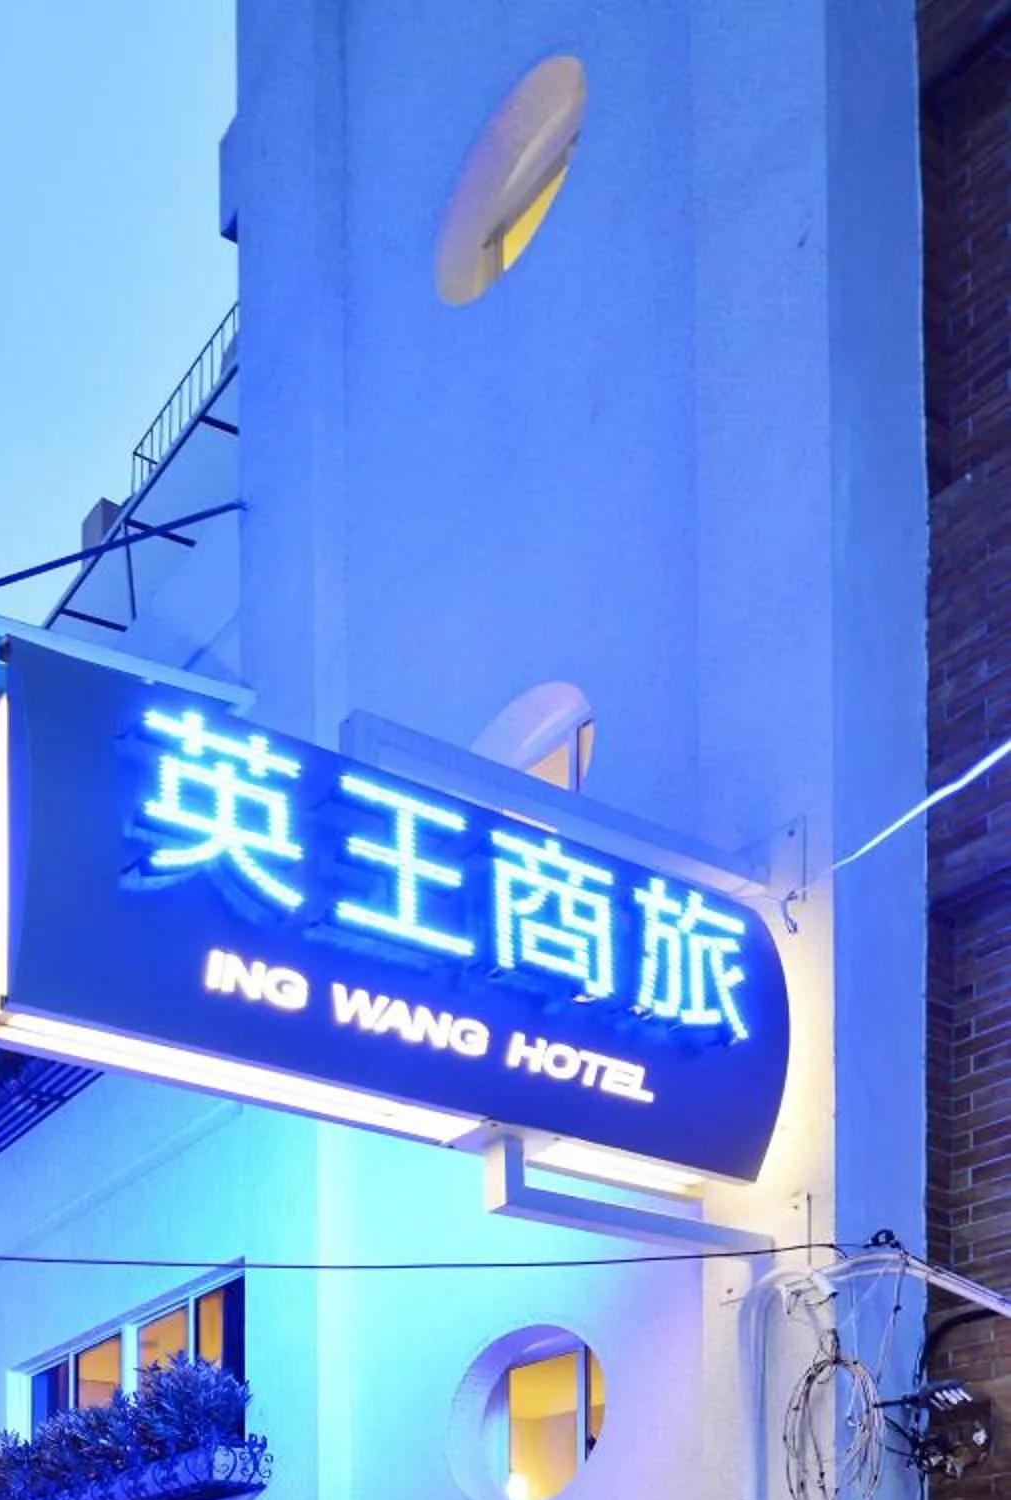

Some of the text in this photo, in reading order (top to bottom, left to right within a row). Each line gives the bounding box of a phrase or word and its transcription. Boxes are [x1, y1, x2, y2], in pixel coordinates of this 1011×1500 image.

[142, 709, 749, 1042] 英王商旅
[206, 949, 655, 1103] ING WANG HOTEL
